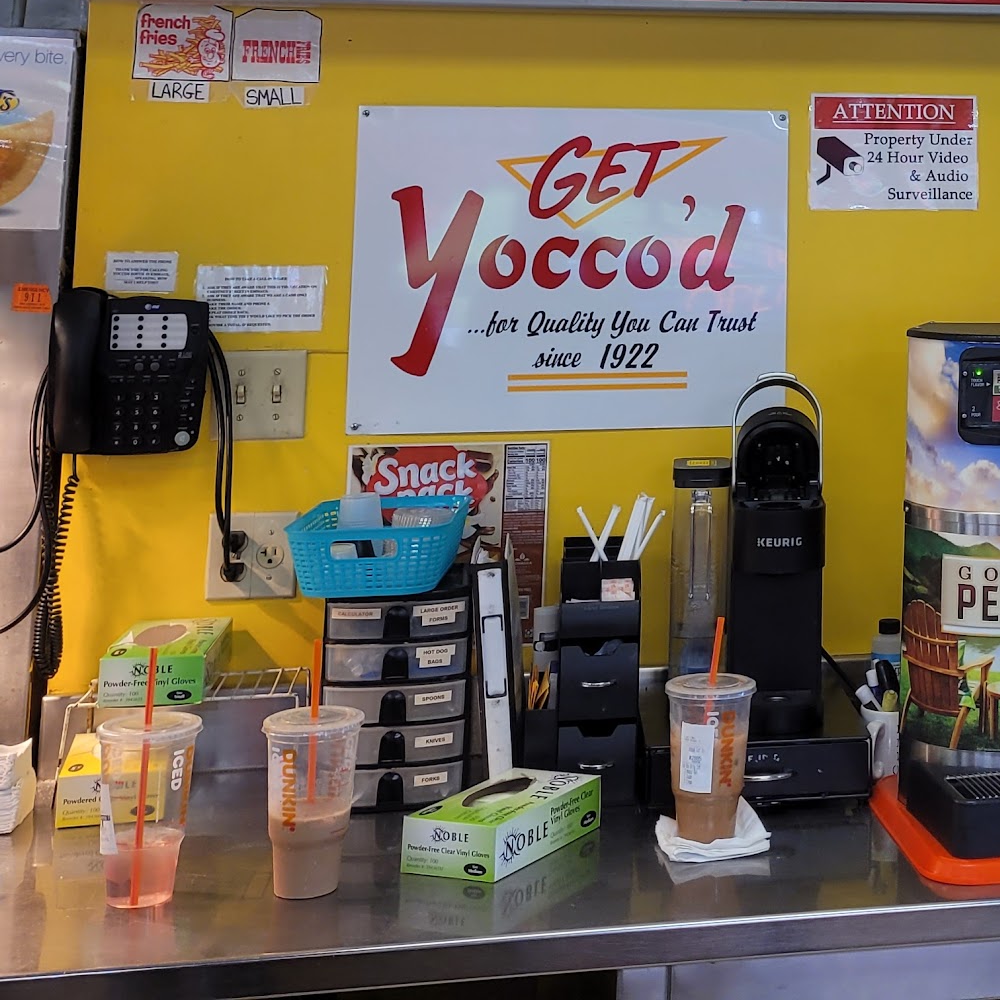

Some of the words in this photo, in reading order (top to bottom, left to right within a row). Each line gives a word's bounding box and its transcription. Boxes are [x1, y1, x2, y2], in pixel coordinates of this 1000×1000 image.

[141, 13, 190, 29] french
[140, 30, 177, 45] fries
[35, 49, 67, 64] bite.
[242, 40, 296, 63] FRENCH
[152, 82, 204, 100] LARGE
[247, 88, 302, 106] SMALL
[832, 103, 955, 120] ATTENTION
[864, 133, 925, 149] Property
[930, 134, 972, 146] Under
[867, 152, 882, 163] 24
[887, 152, 924, 163] Hour
[928, 152, 968, 163] Video
[529, 136, 680, 219] GET
[910, 171, 920, 181] &
[926, 170, 968, 182] Audio
[888, 188, 972, 200] Surveillance
[526, 310, 603, 339] Quality
[611, 310, 650, 339] You
[659, 310, 698, 332] Can
[707, 310, 759, 332] Trust
[532, 349, 581, 368] since
[599, 343, 659, 370] 1922
[373, 451, 477, 495] Snack
[757, 537, 802, 548] KEURIG
[432, 826, 469, 843] NOBLE
[408, 844, 439, 854] Powder-Free
[457, 848, 470, 858] Vinyl
[472, 850, 489, 858] Gloves
